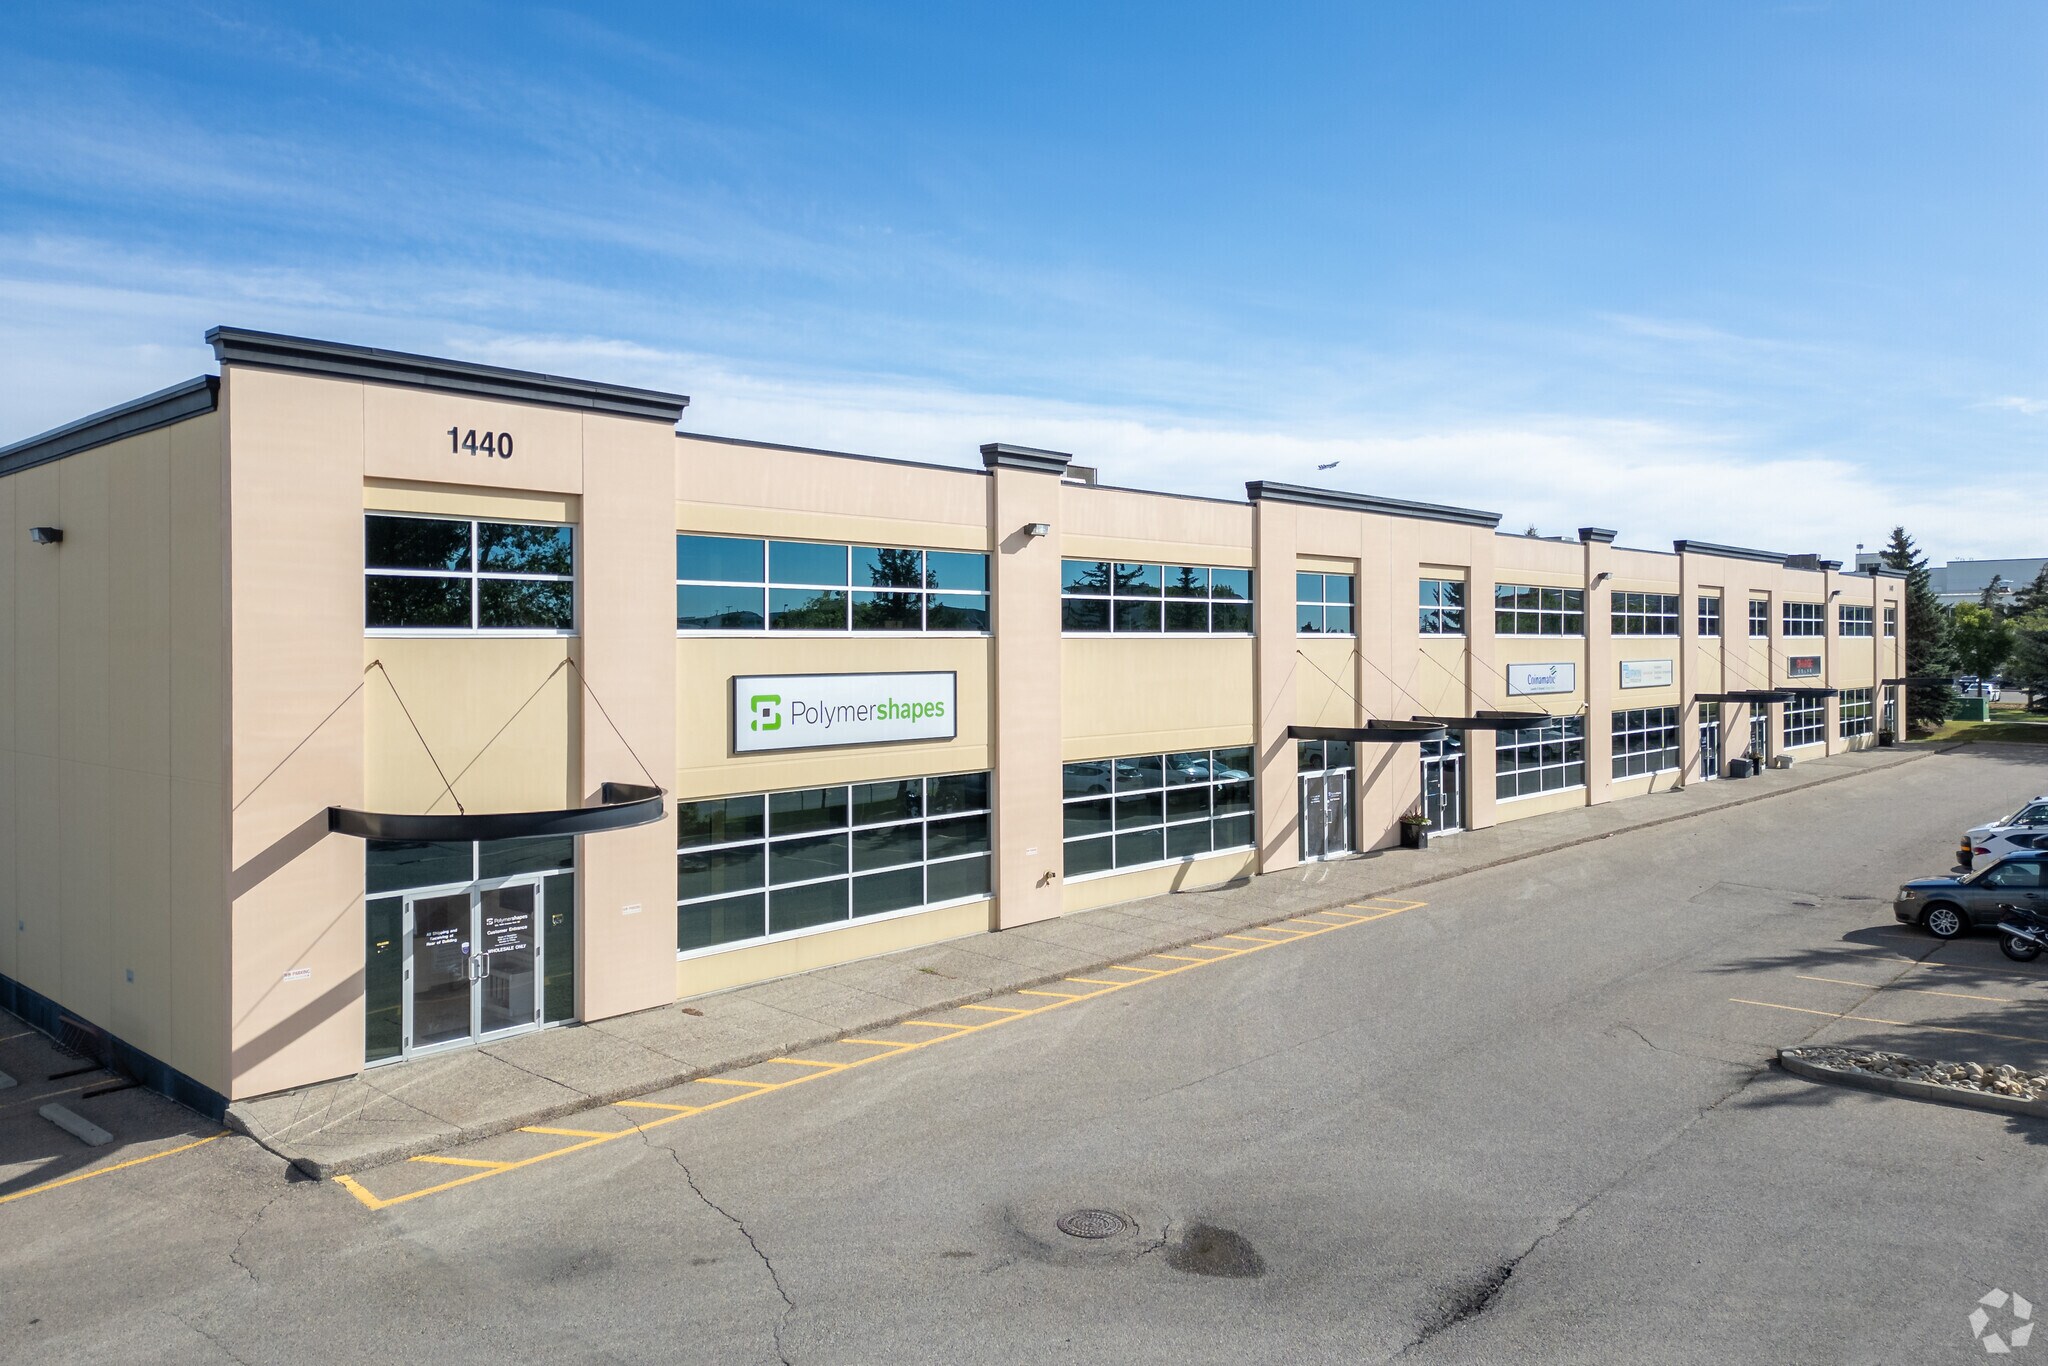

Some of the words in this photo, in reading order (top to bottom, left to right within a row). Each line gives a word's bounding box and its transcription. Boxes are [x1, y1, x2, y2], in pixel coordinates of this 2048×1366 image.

[447, 426, 514, 459] 1440
[1527, 674, 1556, 685] Coinamatic
[791, 698, 945, 728] Polymershapes
[493, 914, 528, 924] Polymershapes
[487, 945, 514, 953] WHOLESALE
